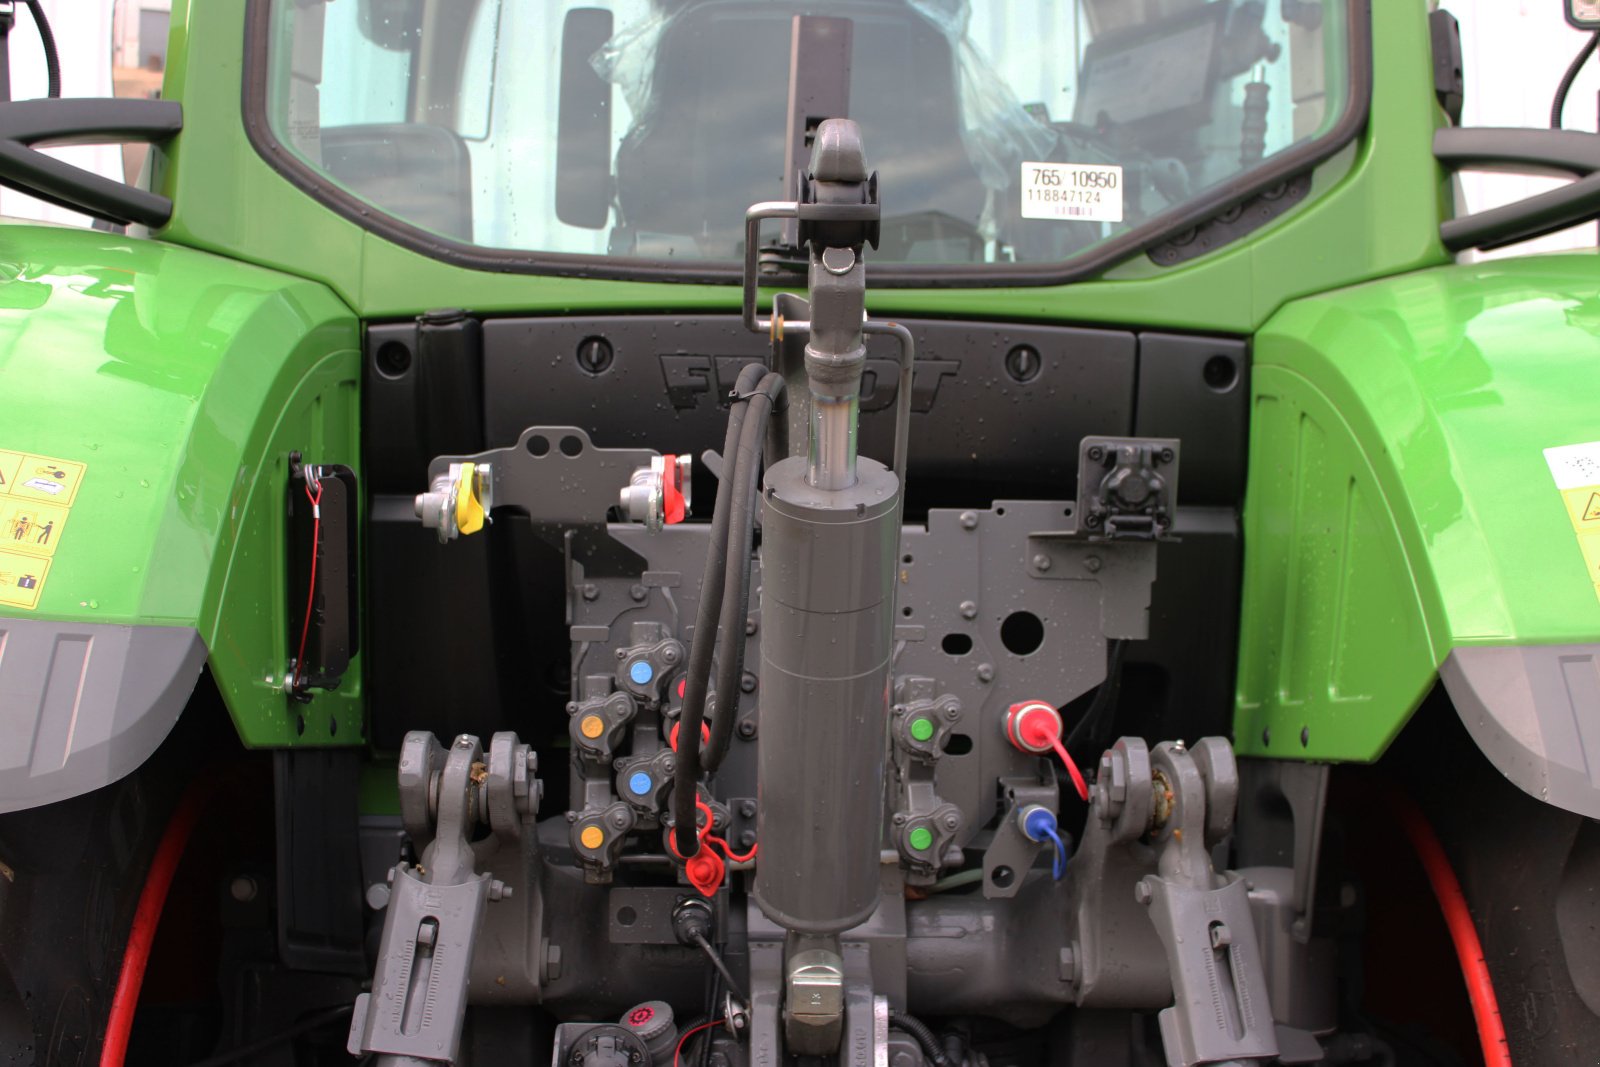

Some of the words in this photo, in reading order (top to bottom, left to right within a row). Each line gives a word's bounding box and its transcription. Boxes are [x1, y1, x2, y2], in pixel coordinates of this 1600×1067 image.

[1033, 168, 1061, 186] 765
[1071, 170, 1117, 189] 10950
[1028, 188, 1101, 203] 118847124
[659, 354, 960, 413] FDT
